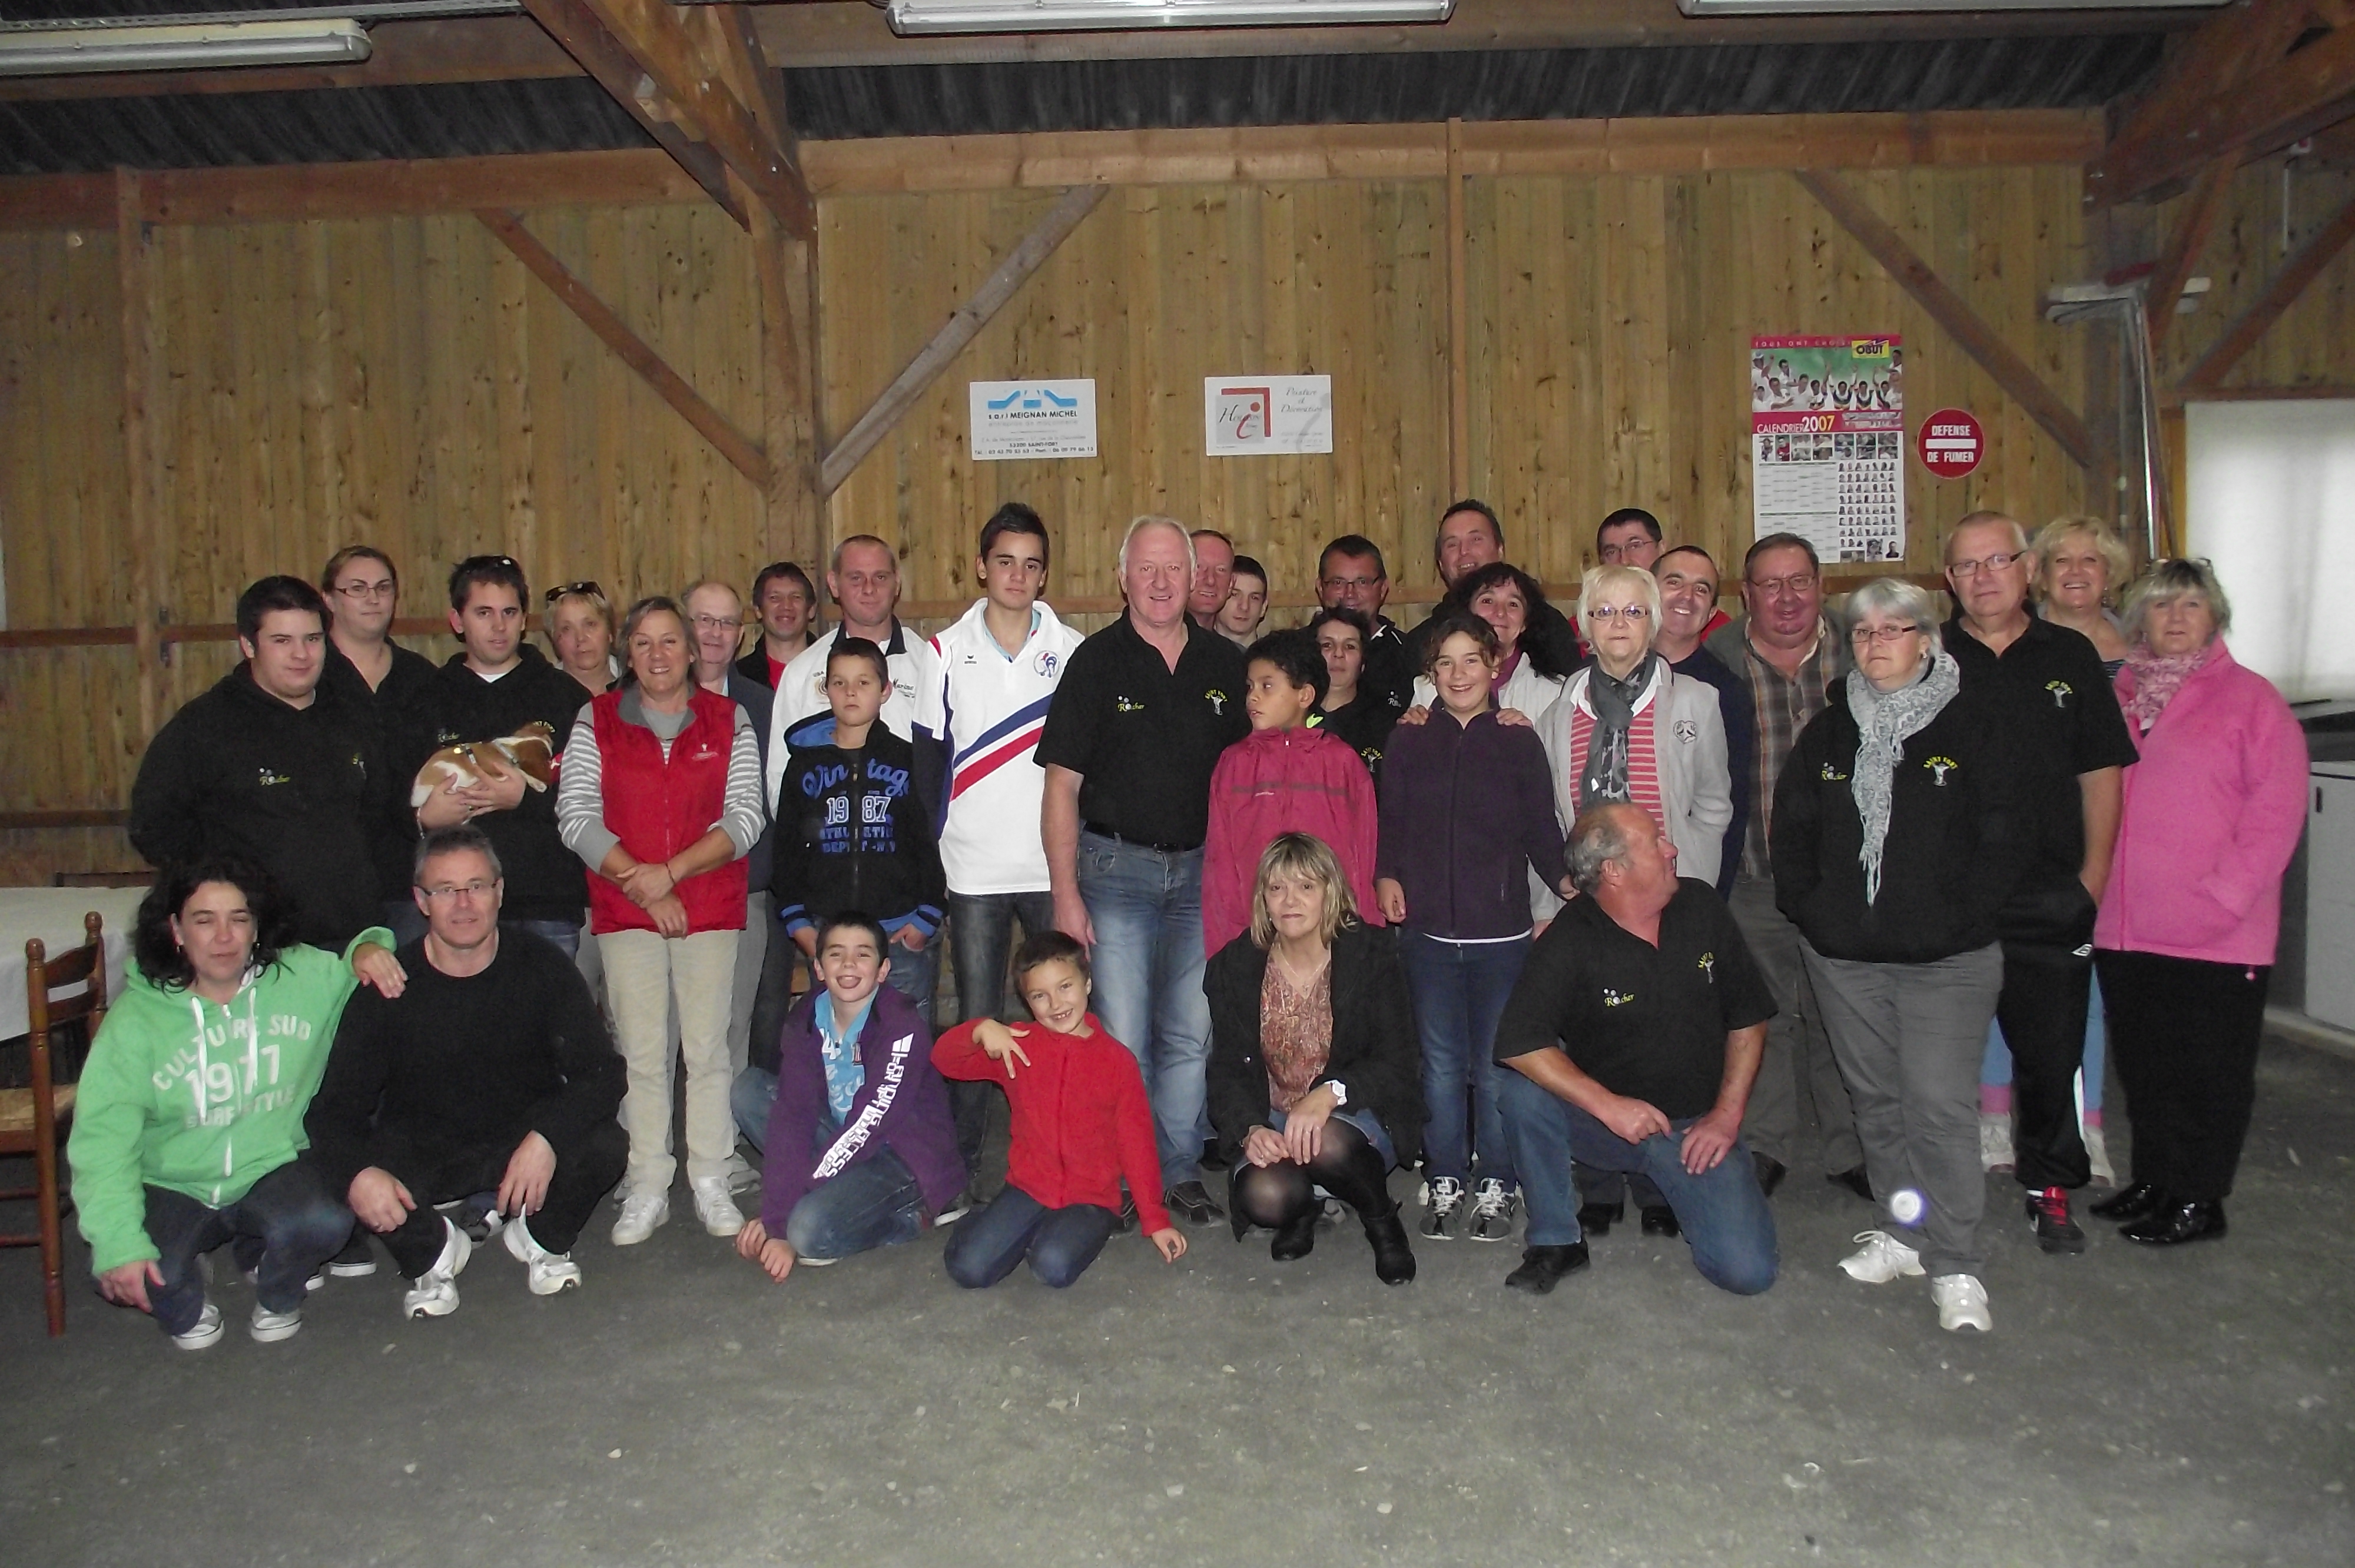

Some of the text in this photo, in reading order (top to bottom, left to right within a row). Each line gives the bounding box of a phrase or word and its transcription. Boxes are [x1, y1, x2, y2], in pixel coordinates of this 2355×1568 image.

[1856, 344, 1883, 356] OBUT
[1756, 423, 1803, 434] CALENDRIER
[1802, 415, 1835, 433] 2007
[1931, 425, 1971, 436] DEFENSE
[1926, 451, 1975, 463] DE FUMER
[152, 1014, 311, 1090] CULUR SUD
